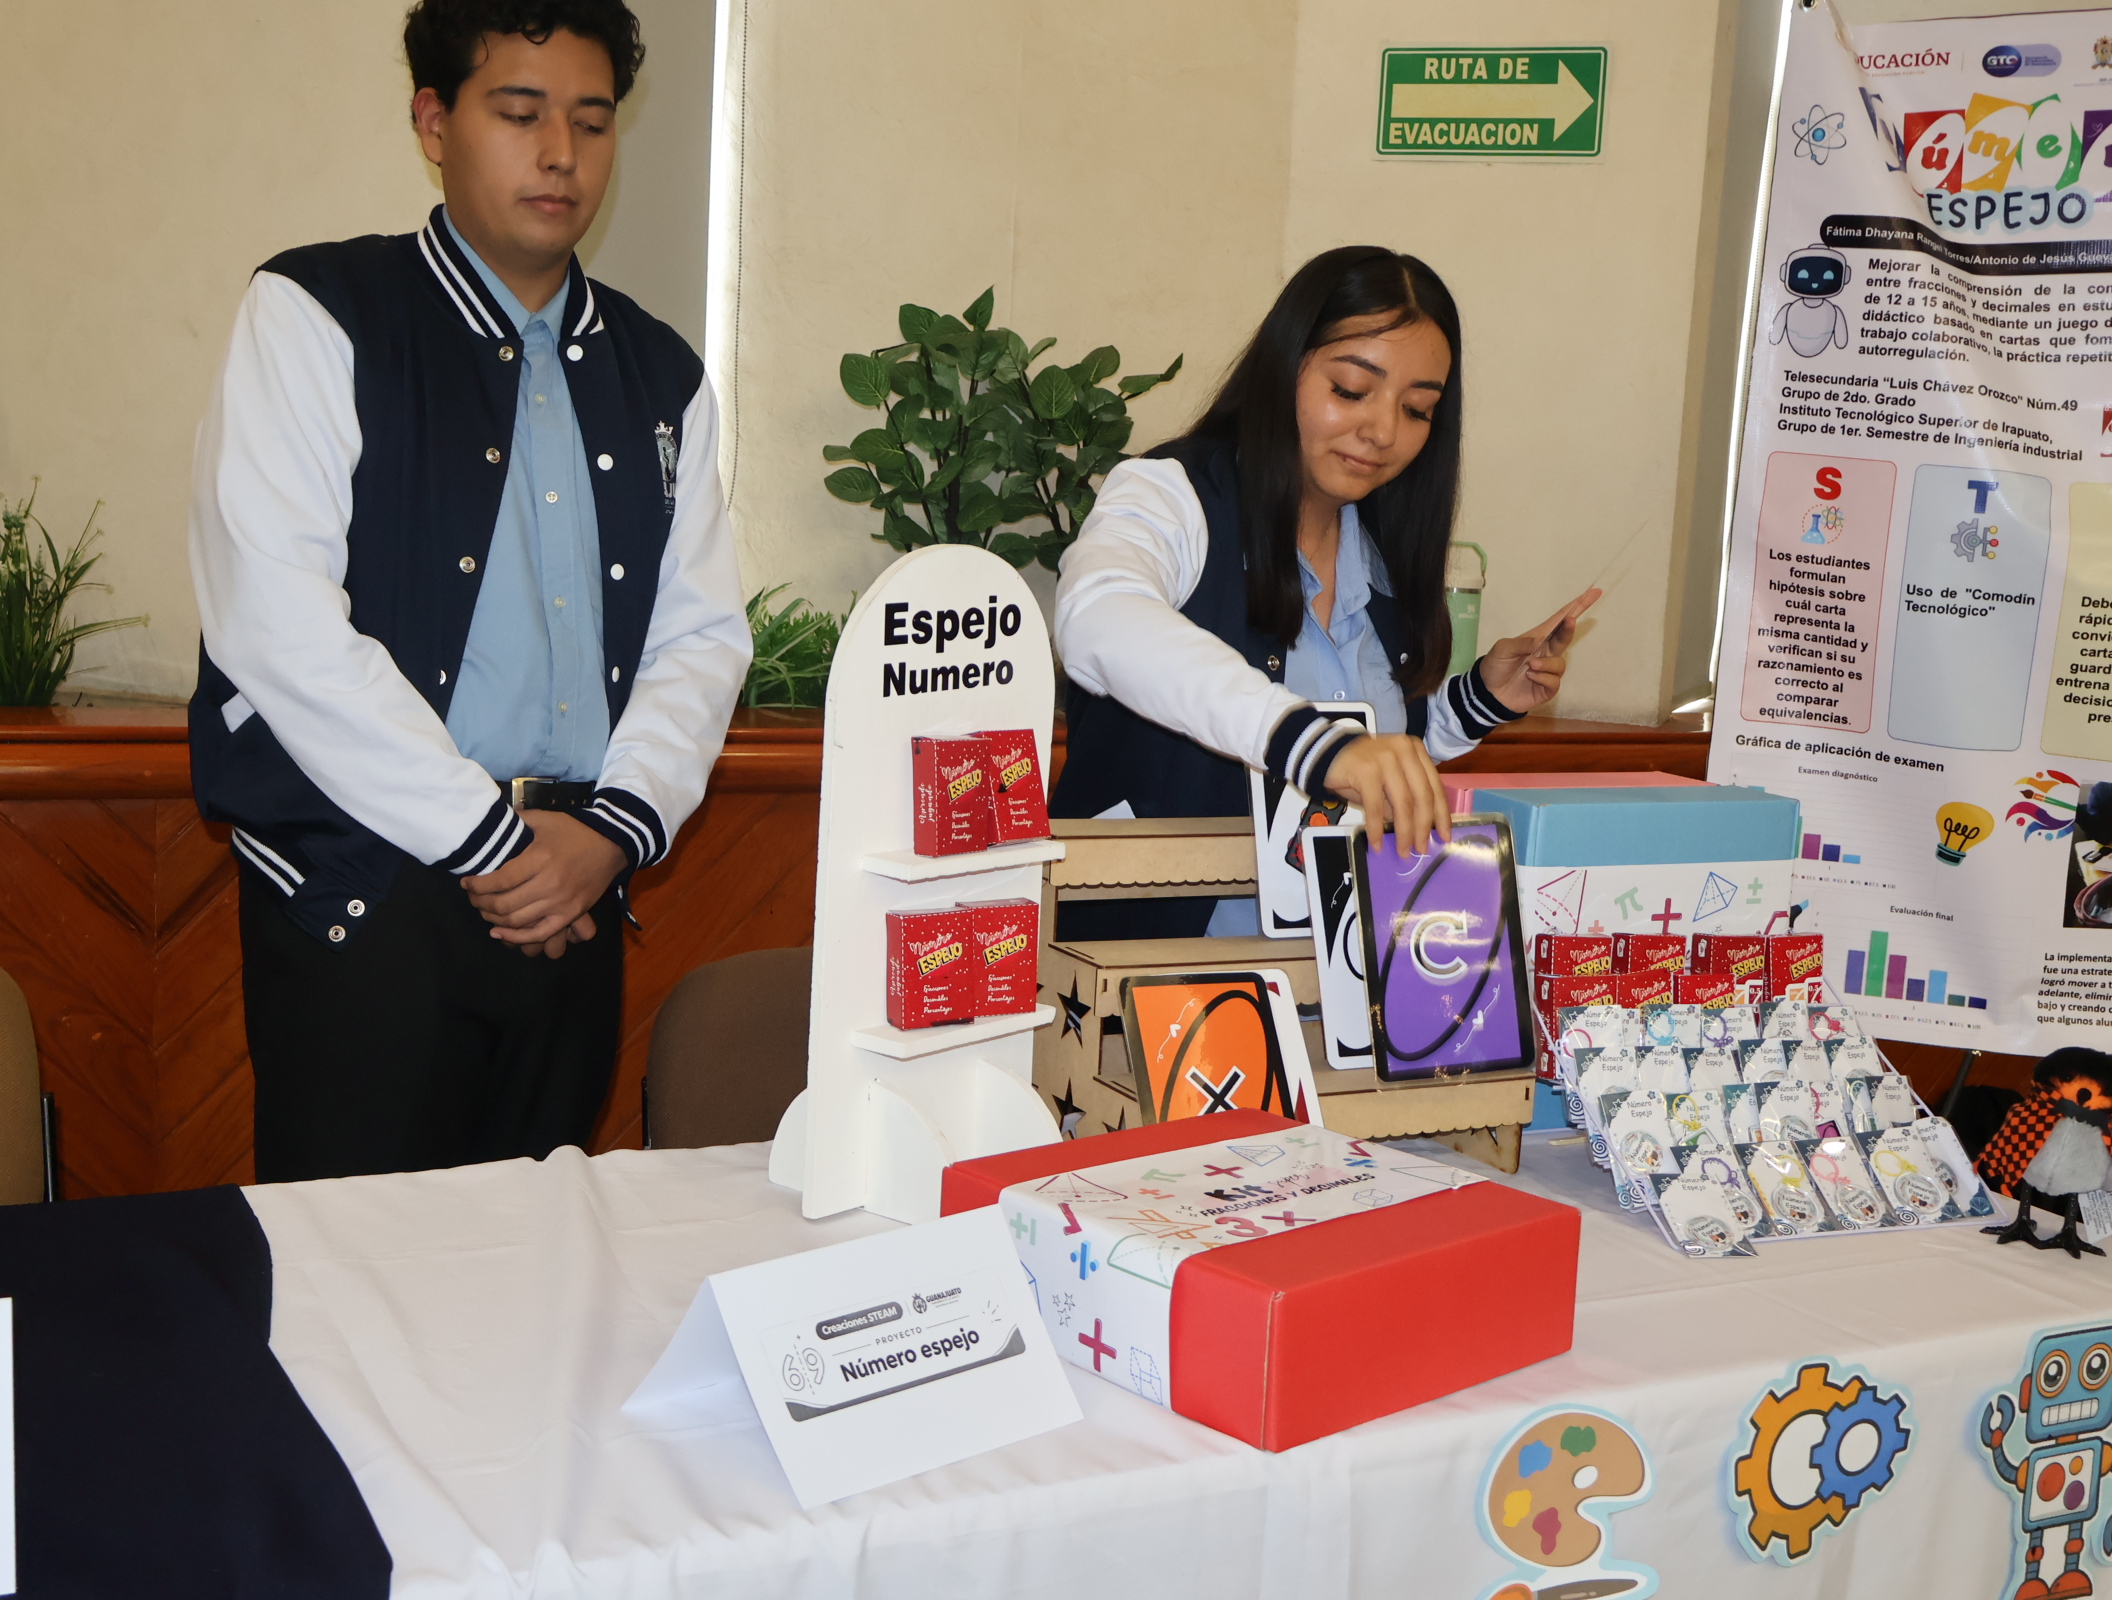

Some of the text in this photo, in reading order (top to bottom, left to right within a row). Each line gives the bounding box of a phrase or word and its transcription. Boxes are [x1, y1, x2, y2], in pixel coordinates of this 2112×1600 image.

[1424, 58, 1529, 79] RUTA DE
[1389, 123, 1538, 145] EVACUACION
[1926, 192, 2087, 229] ESPEJO
[1826, 226, 1862, 237] Fátima
[1865, 227, 1914, 240] Dhayana
[1917, 232, 1943, 253] Rangel
[2023, 254, 2037, 264] de
[2040, 252, 2075, 264] Jesús
[1869, 259, 1921, 273] Mejorar
[1931, 264, 1940, 276] la
[1948, 273, 2022, 296] comprensión
[2034, 285, 2051, 295] de
[2064, 284, 2075, 294] la
[1866, 277, 1900, 288] entre
[1908, 277, 1966, 302] fracciones
[1971, 298, 1976, 308] y
[1982, 300, 2050, 312] decimales
[2059, 302, 2075, 311] en
[1865, 294, 2097, 332] de 12 a 15 años, mediante un juego
[1863, 310, 1925, 324] didáctico
[1934, 313, 1974, 333] basado
[1980, 330, 1993, 341] en
[2000, 333, 2040, 345] cartas
[2049, 336, 2076, 348] que
[1859, 344, 1969, 362] autorregulación.
[1861, 328, 1907, 342] trabajo
[1912, 331, 1990, 356] colaborativo,
[1994, 345, 2002, 358] la
[2007, 351, 2061, 363] práctica
[1782, 387, 1916, 407] Grupo de 2do. Grado
[1784, 371, 1878, 387] Telesecundaria
[1923, 380, 1974, 395] Chávez
[2027, 398, 2078, 411] Núm.49
[1779, 403, 2053, 444] Instituto Tecnológico Superior de Irapuato,
[1778, 420, 2082, 461] Grupo de 1er. Semestre de Ingeniería industrial
[1813, 467, 1842, 500] S
[1968, 480, 1999, 514] T
[1770, 549, 1870, 571] Los estudiantes
[1790, 566, 1846, 584] formulan
[1769, 580, 1865, 602] hipótesis sobre
[1907, 584, 2035, 606] Uso de "Comodín
[1786, 597, 1846, 616] cuál carta
[1905, 600, 1995, 618] Tecnológico"
[884, 595, 1021, 653] Espejo
[1774, 612, 1855, 633] representa la
[1758, 627, 1868, 652] misma cantidad y
[1768, 642, 1855, 664] verifican si su
[883, 660, 1013, 697] Numero
[1758, 658, 1863, 680] razonamiento es
[1775, 675, 1843, 693] correcto al
[2056, 677, 2109, 690] entrena
[1777, 691, 1839, 708] comparar
[1759, 706, 1851, 725] equivalencias.
[1736, 734, 1945, 772] Gráfica de aplicación de examen
[1000, 758, 1032, 788] ESPEJO
[1798, 766, 1878, 782] Examen diagnóstico
[948, 769, 982, 801] ESPEJO
[1890, 905, 1953, 921] Evaluación final
[917, 942, 962, 976] ESPEJO
[984, 934, 1027, 965] ESPEJO
[1790, 953, 1822, 980] ESPEJO
[2043, 965, 2058, 974] fue
[2041, 977, 2065, 986] logró
[2068, 980, 2098, 988] mover
[2038, 989, 2082, 1000] adelante,
[2038, 1000, 2057, 1011] bajo
[2068, 1004, 2106, 1012] creando
[2037, 1015, 2093, 1025] que algunos
[1200, 1194, 1287, 1216] FRACCIONES
[1300, 1173, 1375, 1194] DECIMALES
[1204, 1184, 1273, 1201] Kit
[926, 1287, 961, 1303] GUANAJUATO
[821, 1306, 897, 1335] Creaciones STEAM
[875, 1327, 922, 1345] PROYECTO
[840, 1328, 979, 1382] Número espejo
